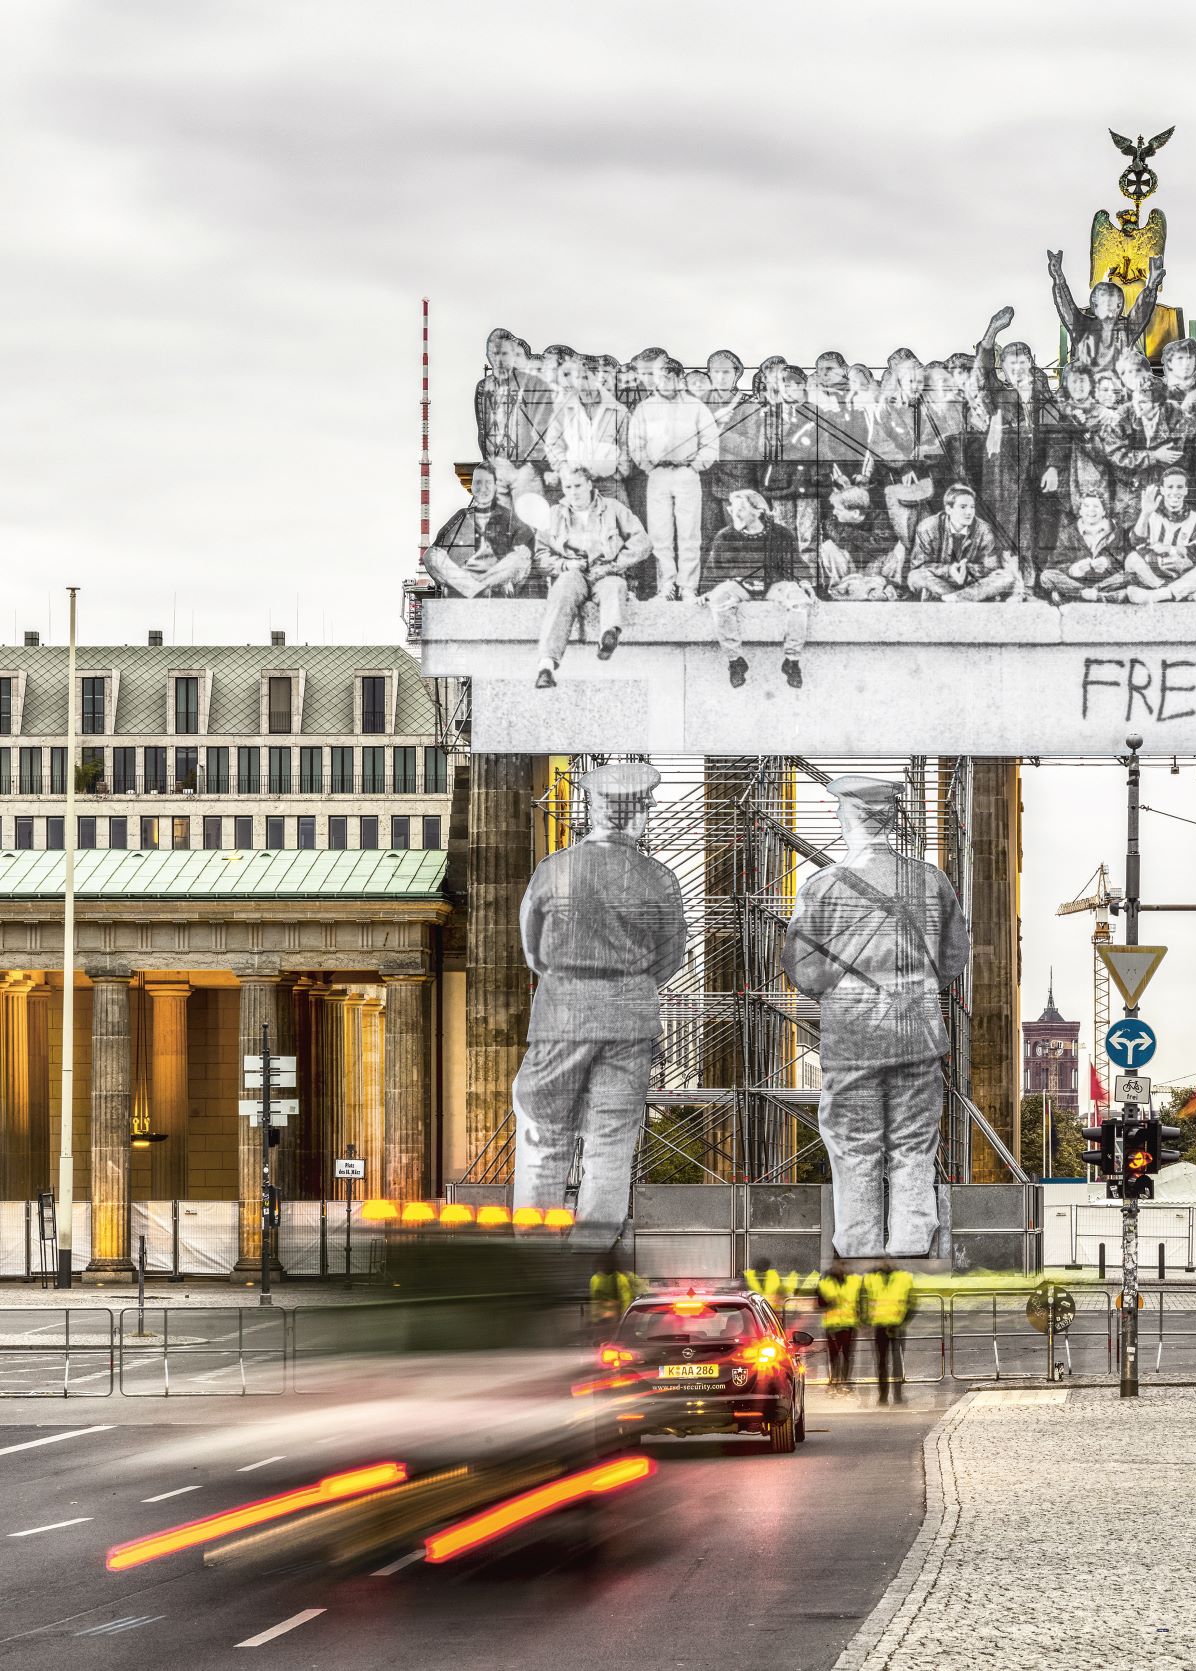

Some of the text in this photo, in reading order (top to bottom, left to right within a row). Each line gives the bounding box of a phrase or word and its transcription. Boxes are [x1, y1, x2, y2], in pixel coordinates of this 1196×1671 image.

[668, 1365, 714, 1376] K AA 286
[652, 1383, 726, 1391] www.rsd-security.com
